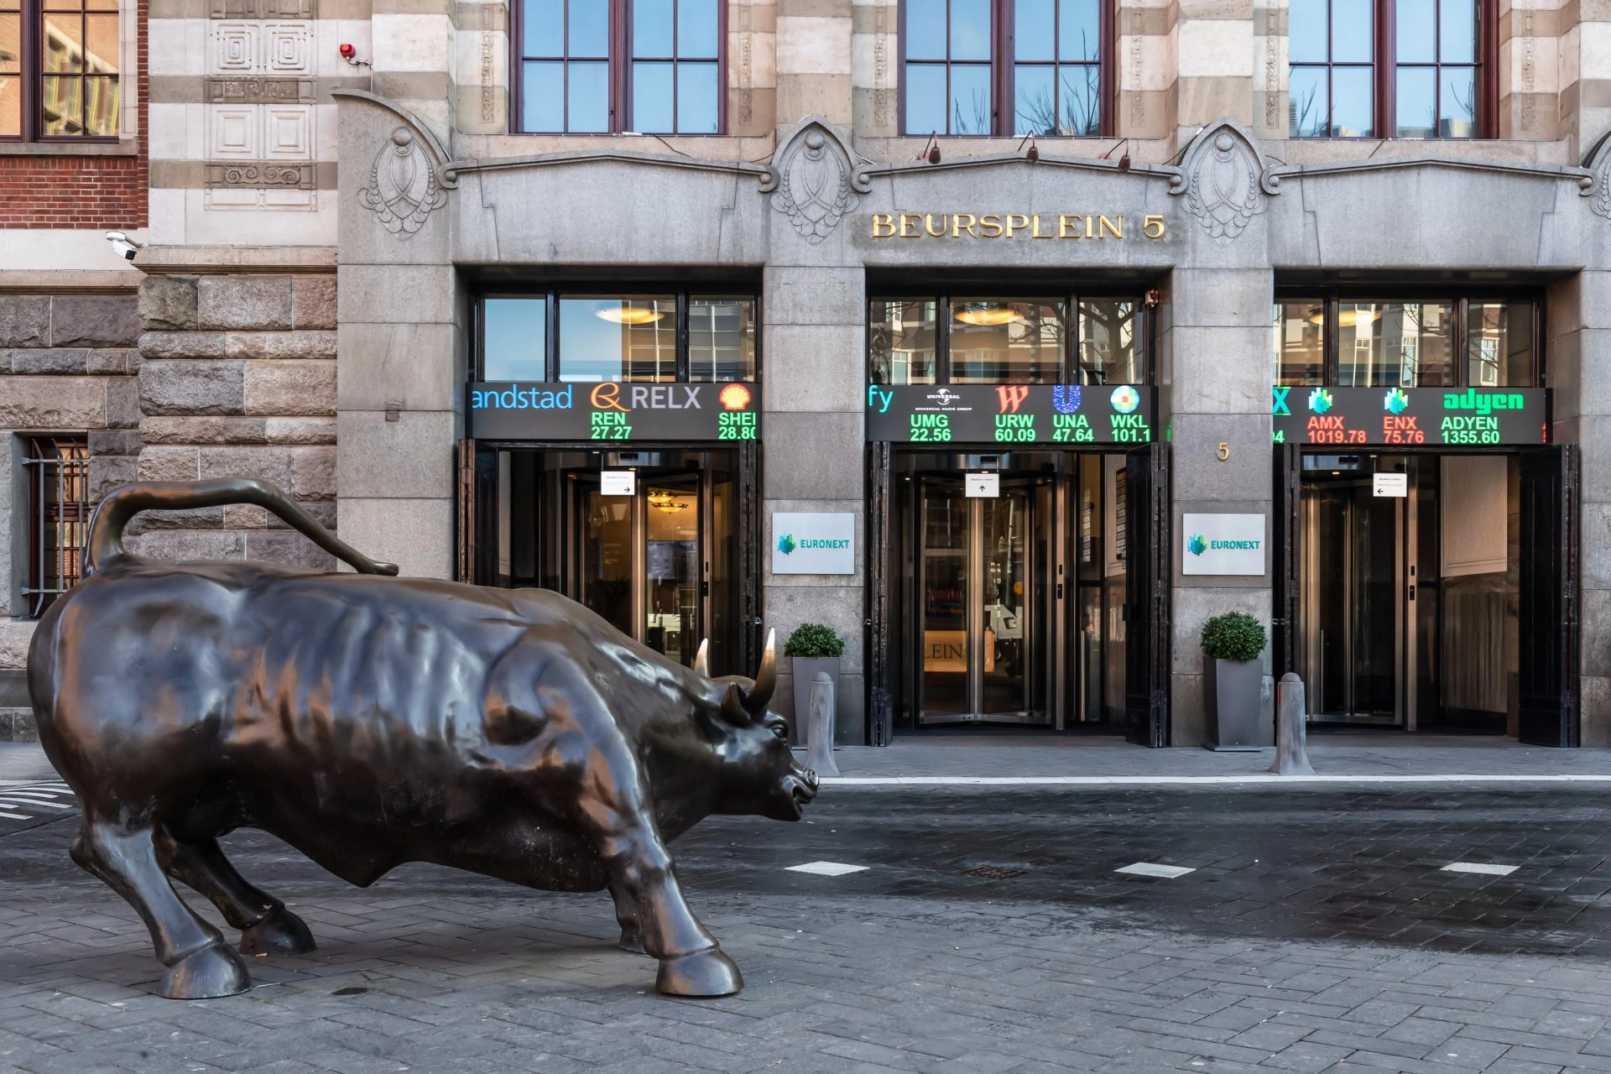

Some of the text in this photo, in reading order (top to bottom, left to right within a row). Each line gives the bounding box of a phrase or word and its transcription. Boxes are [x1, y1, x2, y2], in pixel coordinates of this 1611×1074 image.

[872, 214, 1165, 239] BEURSPLEIN 5
[472, 384, 573, 409] andstad
[631, 386, 701, 409] RELX
[868, 384, 893, 413] fy
[1443, 388, 1524, 415] adyen
[591, 412, 626, 426] REN
[910, 414, 949, 428] UMG
[994, 414, 1034, 428] URW
[1052, 414, 1089, 428] UNA
[1110, 414, 1149, 428] WKL
[1307, 416, 1344, 430] AMX
[1383, 416, 1417, 430] ENX
[1440, 416, 1498, 430] ADYEN
[590, 426, 633, 439] 27.27
[909, 428, 951, 442] 22.56
[994, 428, 1036, 442] 60.09
[1052, 428, 1095, 442] 47.64
[1111, 428, 1151, 442] 101.1
[1307, 430, 1367, 444] 1019.78
[1383, 430, 1425, 444] 75.76
[1441, 430, 1500, 444] 1355.60
[1216, 442, 1230, 460] 5
[800, 539, 850, 549] EURONEXT
[1210, 540, 1261, 550] EURONEXT
